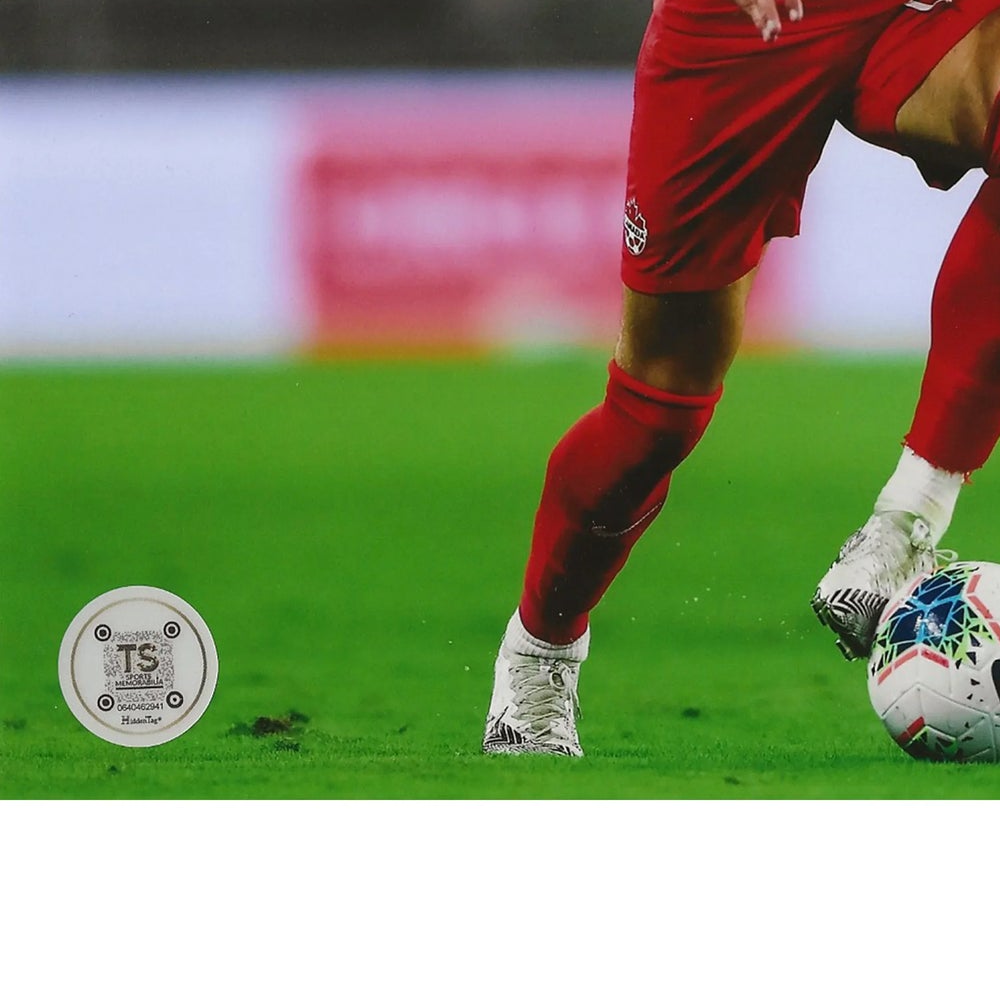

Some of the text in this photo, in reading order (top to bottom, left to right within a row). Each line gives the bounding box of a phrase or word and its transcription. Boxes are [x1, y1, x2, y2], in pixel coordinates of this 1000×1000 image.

[116, 643, 160, 673] TS
[125, 673, 152, 681] SPORTS
[115, 678, 164, 687] MEMORABILIA
[117, 702, 164, 712] 0640462941
